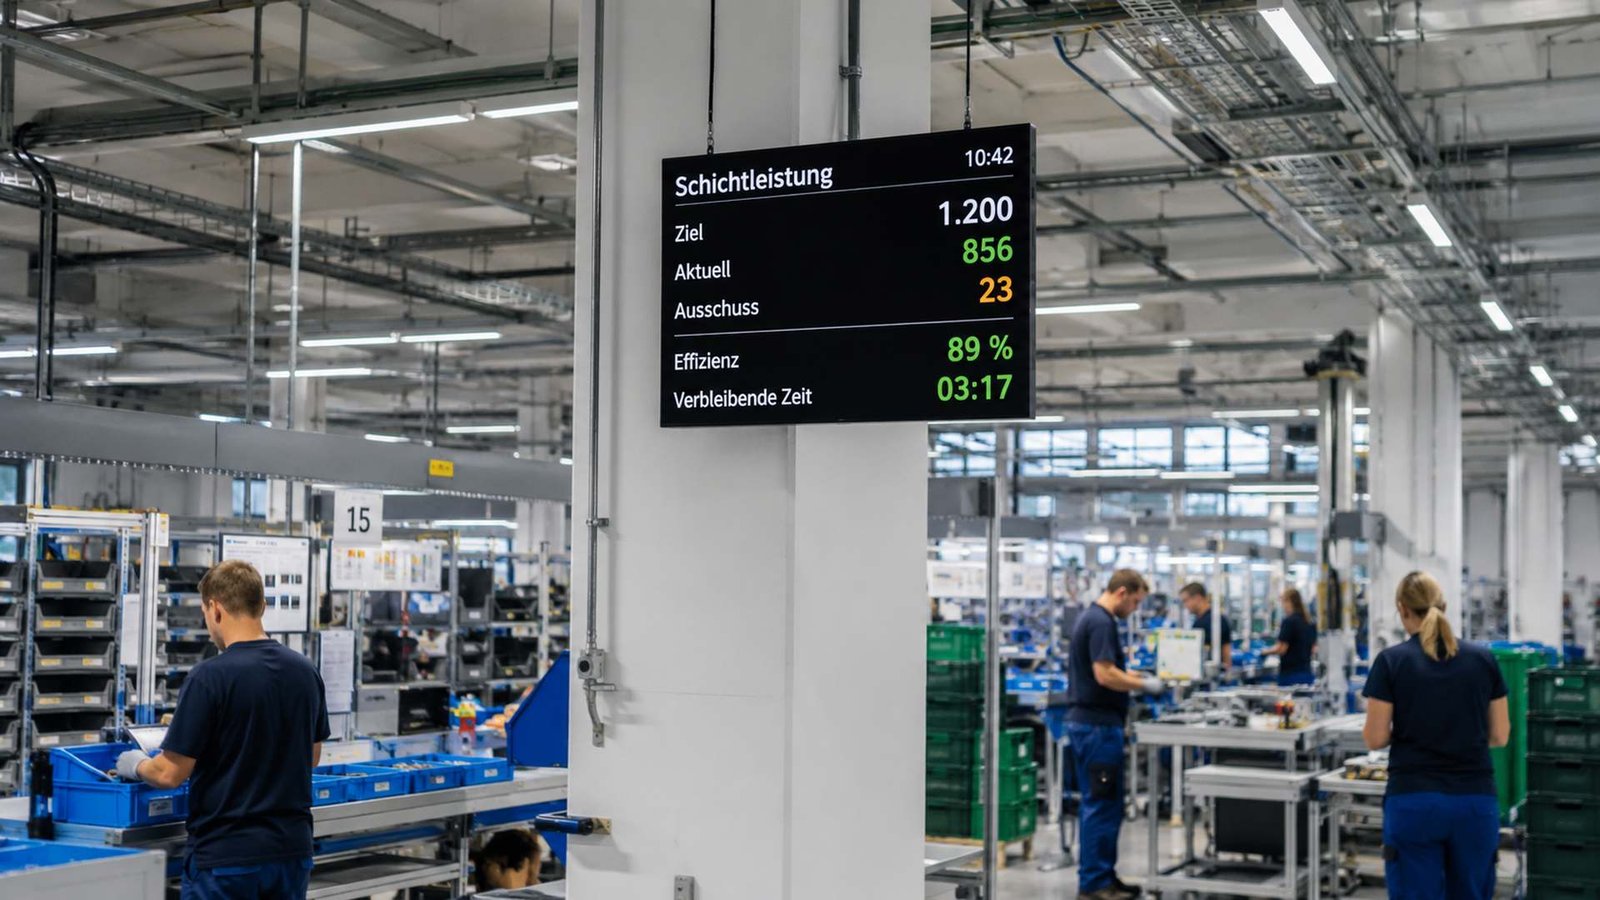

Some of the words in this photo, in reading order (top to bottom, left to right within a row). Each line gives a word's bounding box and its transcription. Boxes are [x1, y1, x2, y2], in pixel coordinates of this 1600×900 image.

[964, 146, 1013, 167] 10:42
[675, 166, 833, 197] Schichtleistung
[938, 196, 1013, 226] 1.200
[674, 223, 703, 242] Ziel
[962, 236, 1013, 264] 856
[674, 260, 731, 281] Aktuell
[979, 276, 1013, 303] 23
[674, 299, 759, 319] Ausschuss
[674, 352, 739, 370] Effizienz
[948, 336, 980, 362] 89
[989, 335, 1013, 360] %
[674, 389, 777, 409] Verbleibende
[781, 388, 813, 406] Zeit
[937, 375, 1013, 402] 03:17
[347, 506, 371, 533] 15
